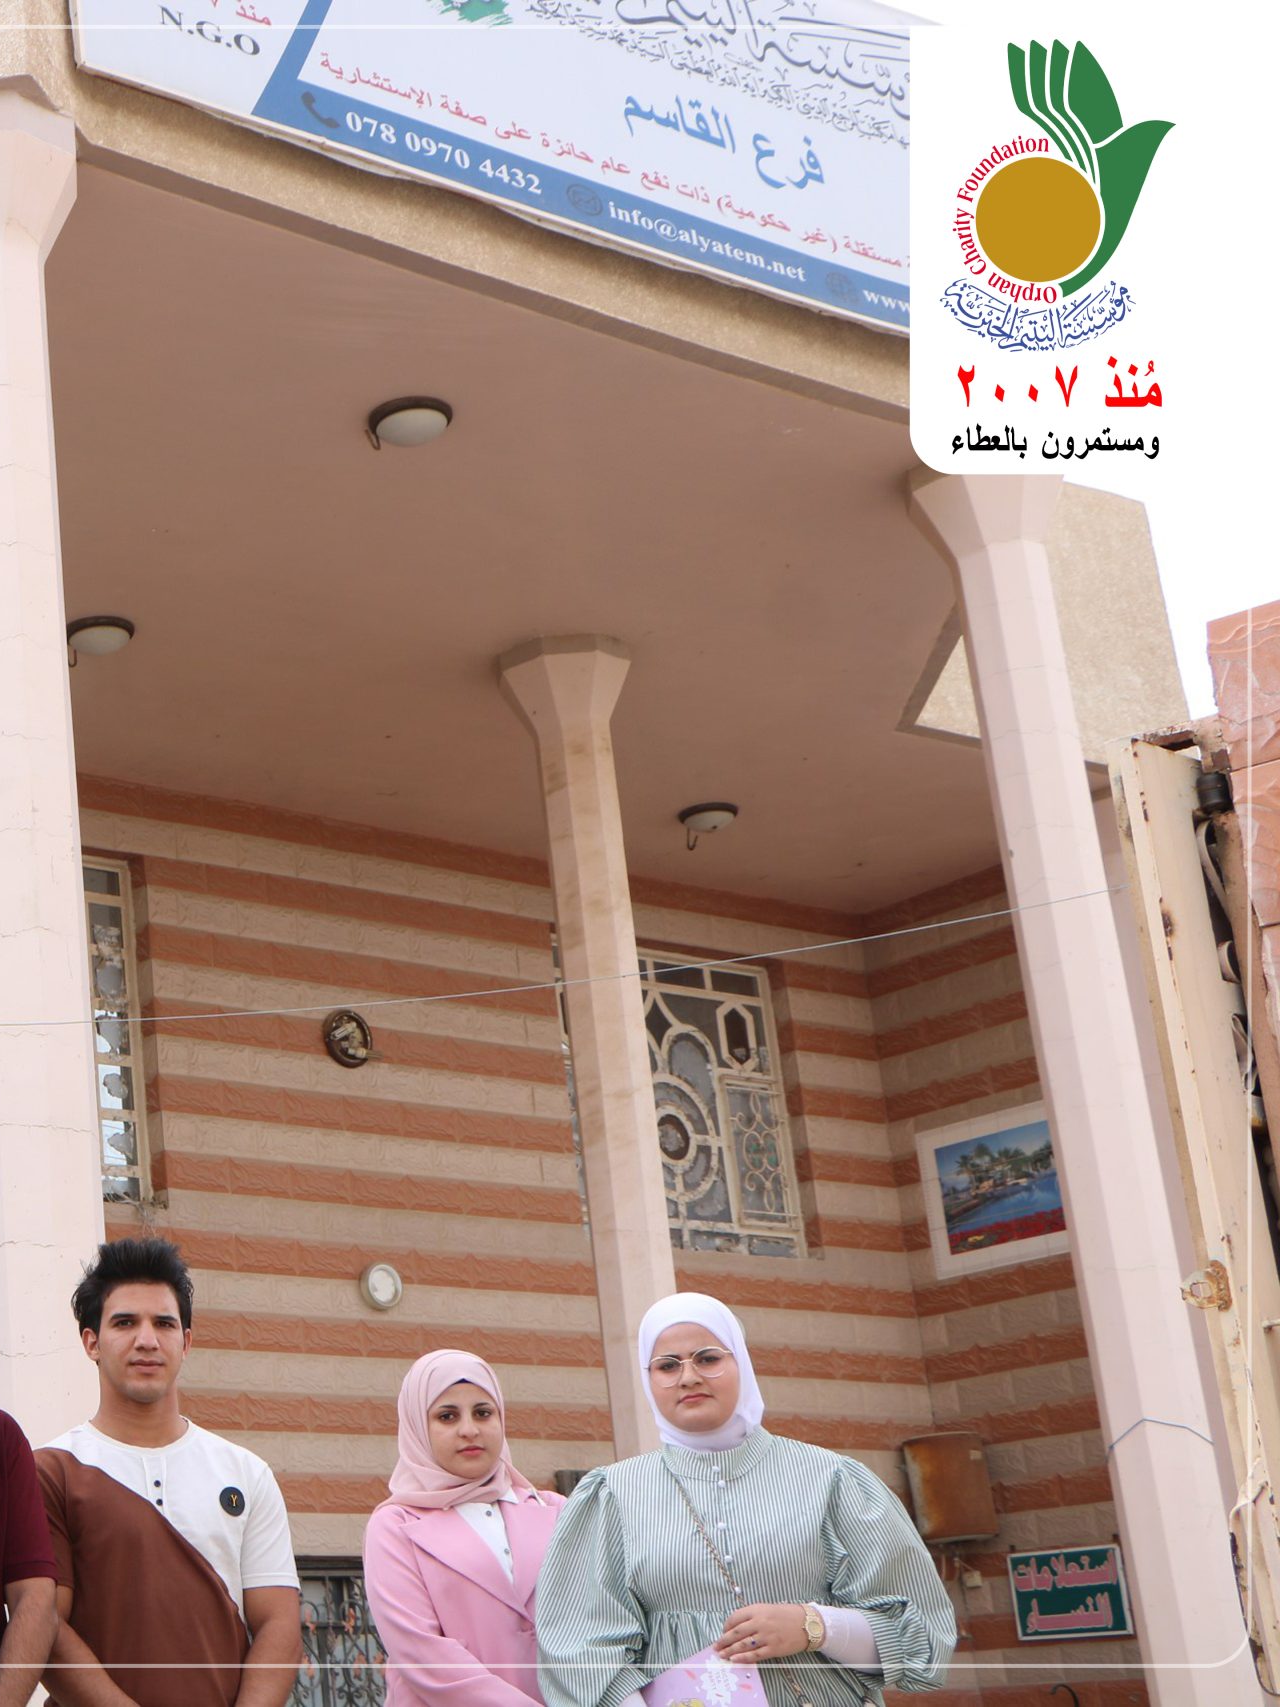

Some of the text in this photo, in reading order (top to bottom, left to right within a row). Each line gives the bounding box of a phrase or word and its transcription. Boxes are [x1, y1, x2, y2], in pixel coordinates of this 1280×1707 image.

[159, 4, 260, 55] N.G.O
[440, 95, 487, 126] صفة
[495, 121, 532, 140] على
[624, 95, 736, 154] القاسم
[345, 111, 542, 194] 078 0970 4432
[601, 157, 631, 174] عام
[752, 133, 825, 189] فرع
[640, 171, 670, 191] نفع
[676, 183, 710, 204] ذات
[608, 201, 807, 282] info@alyatem.net
[1013, 1549, 1118, 1592] استعلامات
[1026, 1592, 1113, 1633] النساء
